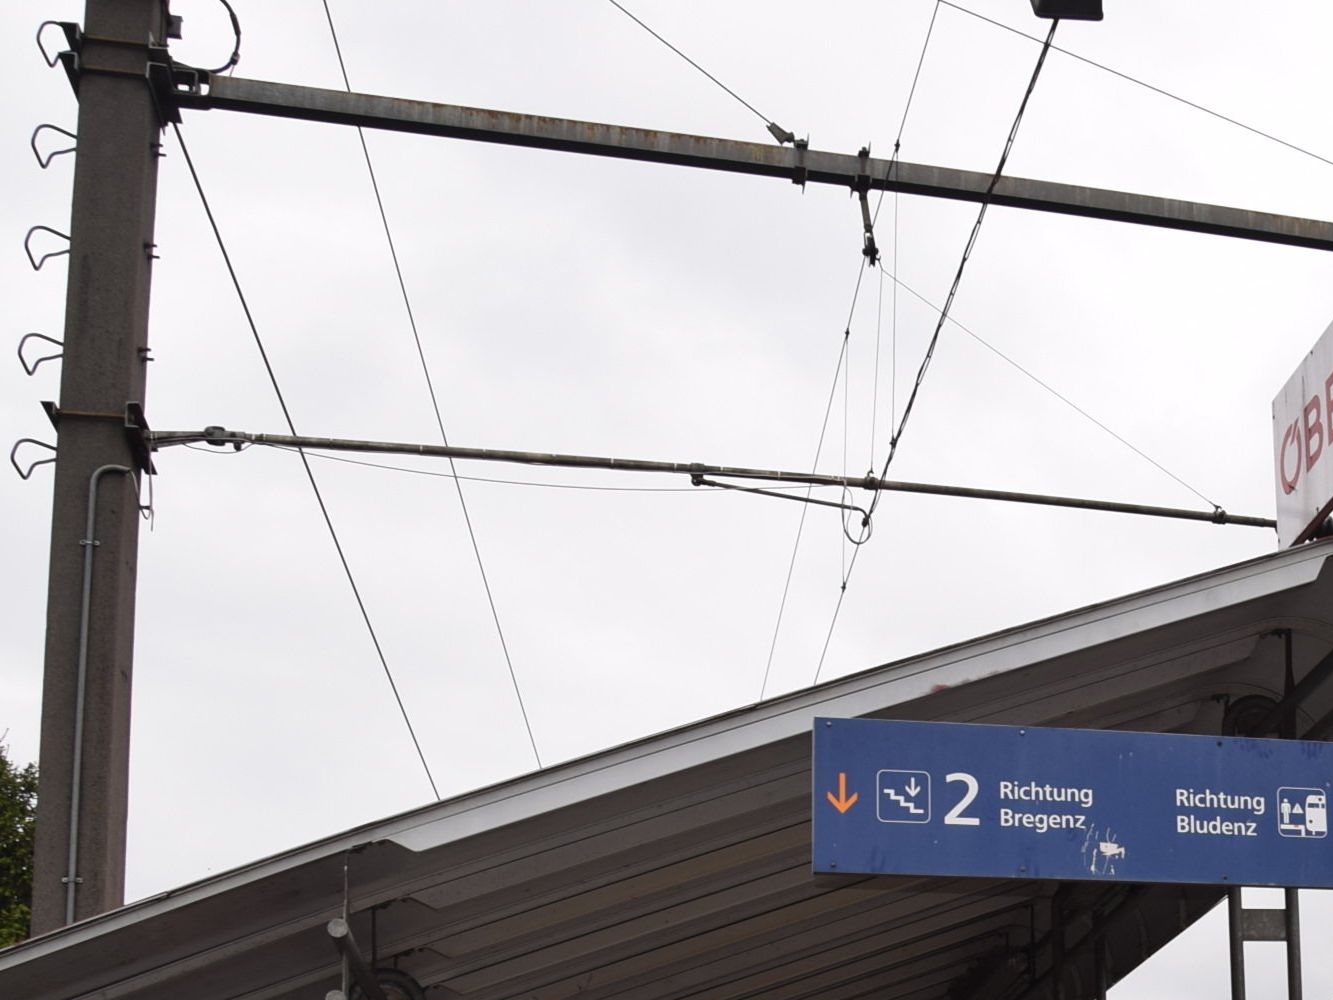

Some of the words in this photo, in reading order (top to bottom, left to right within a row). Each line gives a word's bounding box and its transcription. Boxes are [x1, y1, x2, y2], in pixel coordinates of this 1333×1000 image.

[944, 772, 980, 826] 2
[999, 781, 1093, 808] Richtung
[1175, 788, 1265, 815] Richtung
[1000, 808, 1087, 833] Bregenz
[1176, 815, 1258, 837] Bludenz
